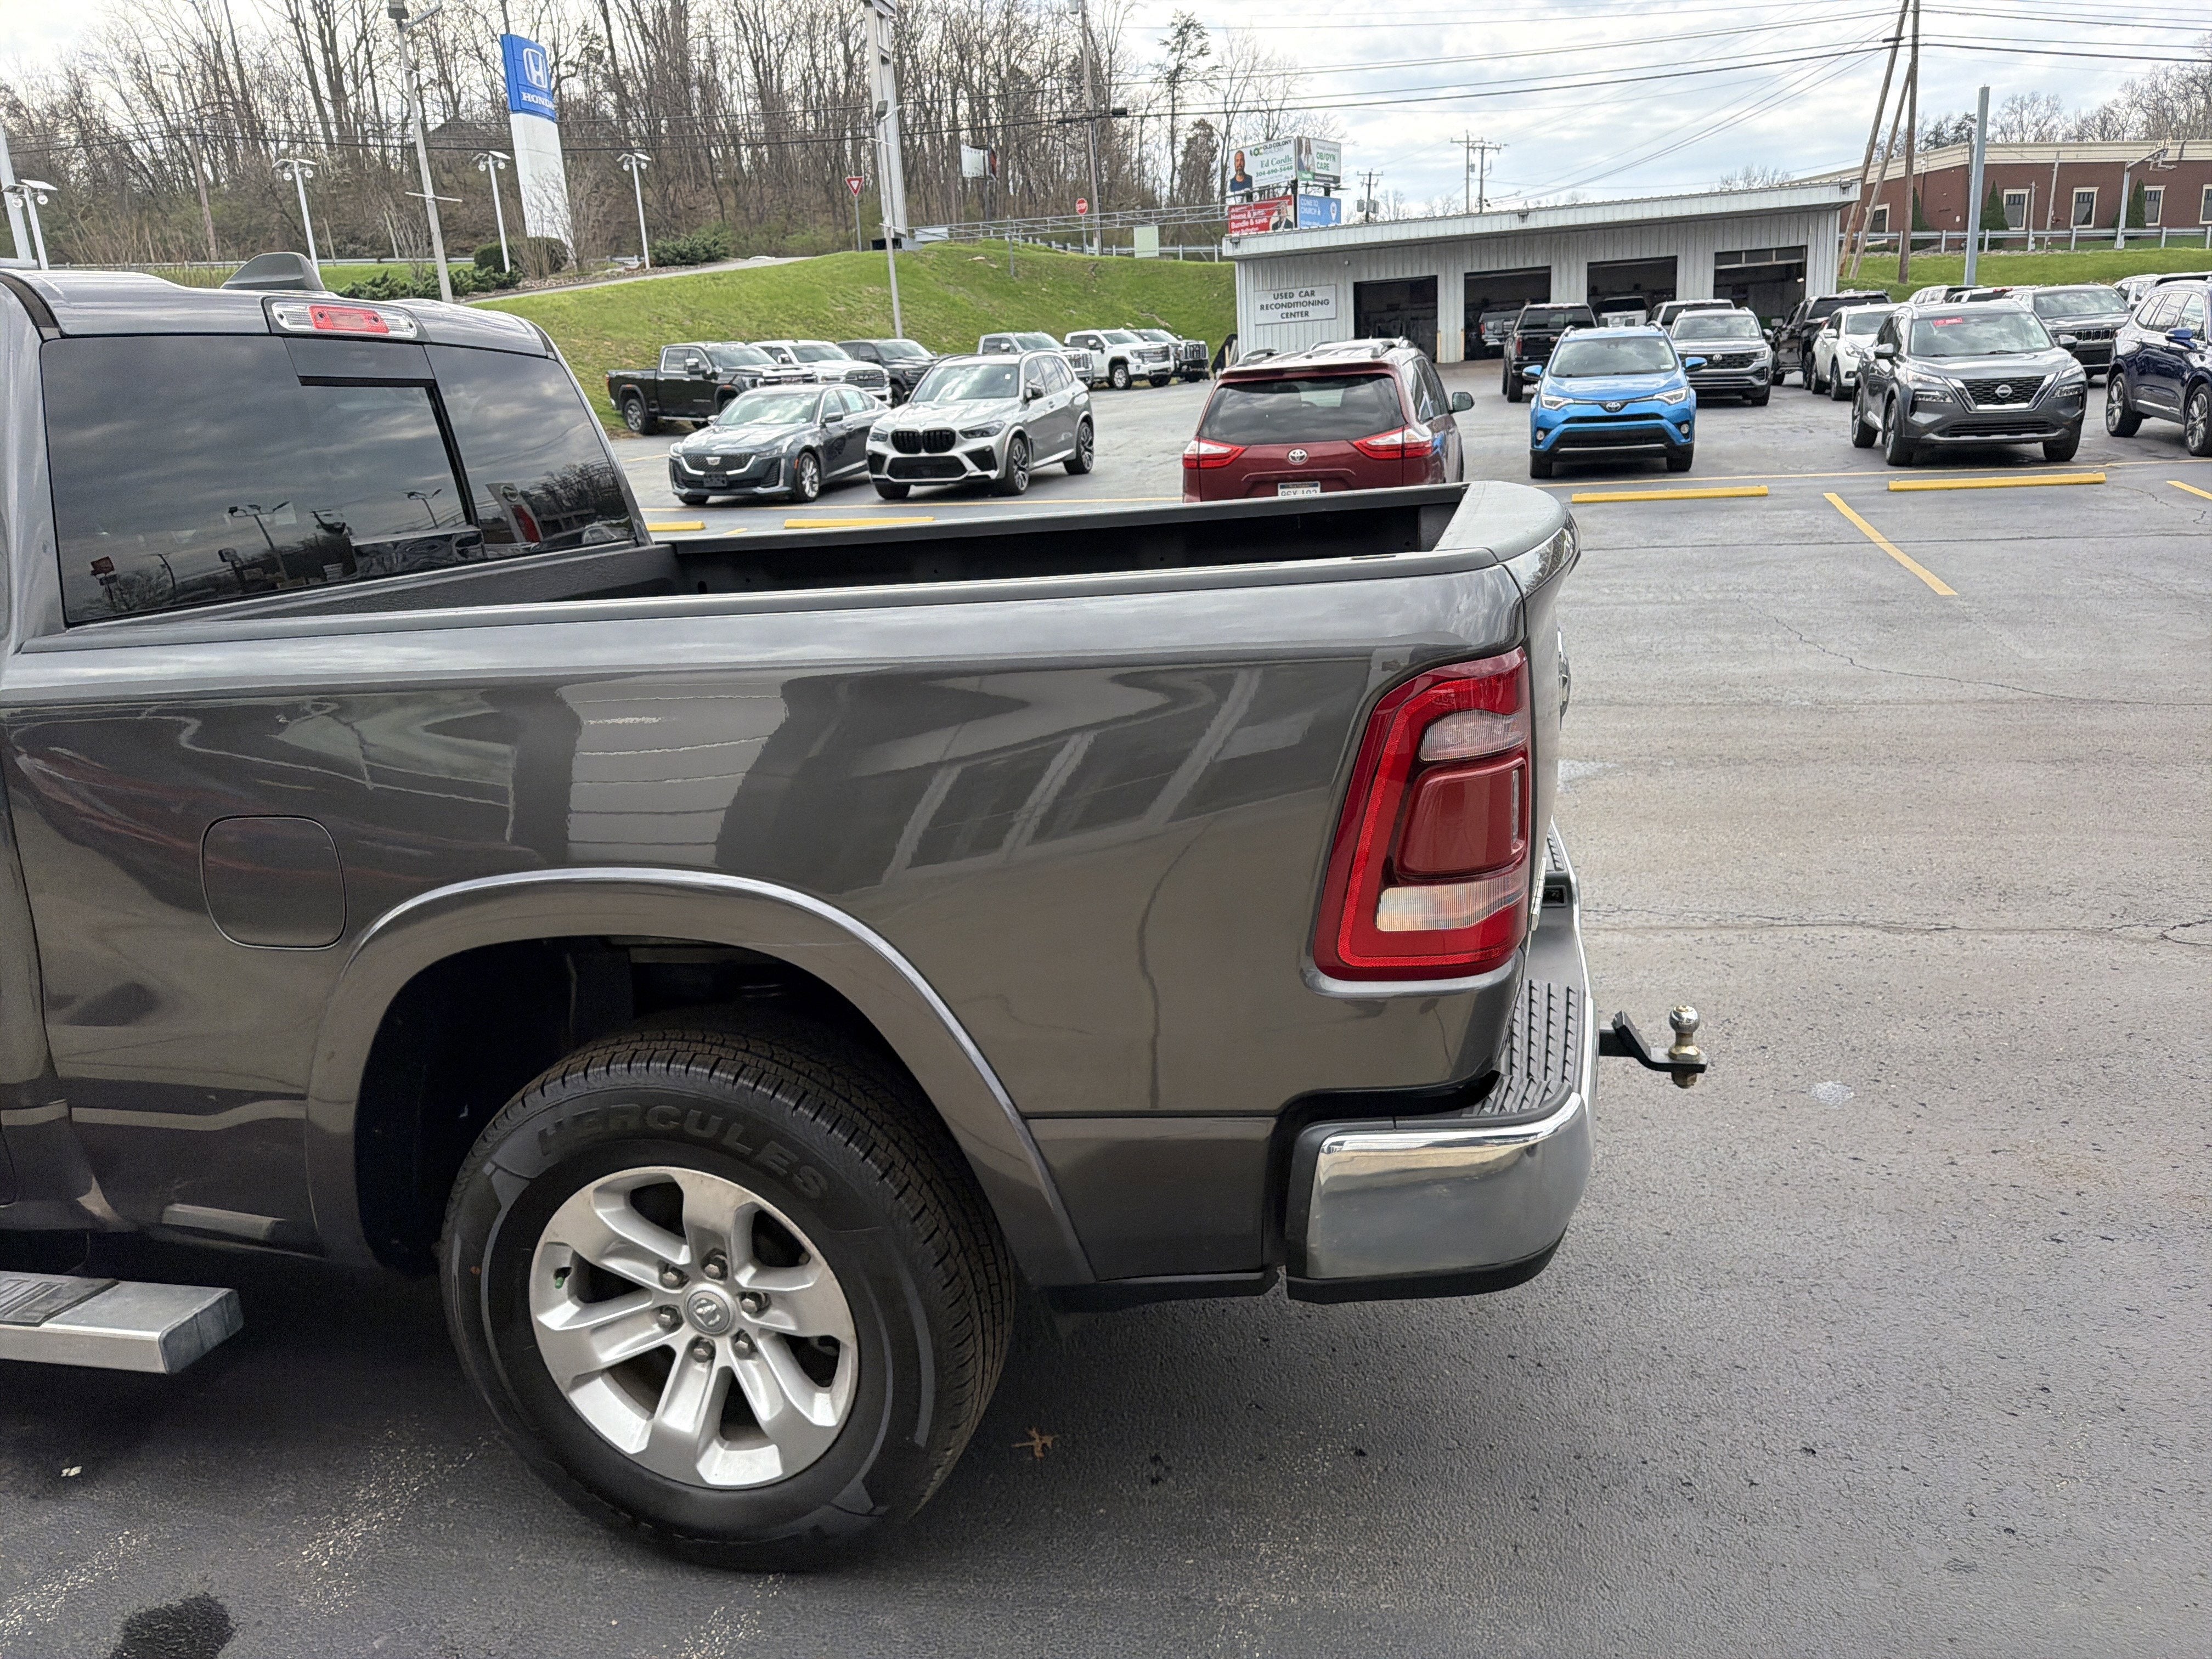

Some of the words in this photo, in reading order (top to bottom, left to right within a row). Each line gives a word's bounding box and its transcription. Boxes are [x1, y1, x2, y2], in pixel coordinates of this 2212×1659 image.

[521, 92, 555, 110] HONDA
[1273, 139, 1292, 148] COLONY
[1261, 159, 1269, 168] Ed
[1316, 161, 1330, 171] CARE
[1273, 291, 1295, 300] USED
[1260, 298, 1330, 311] RECONDITIONING
[1280, 311, 1310, 319] CENTER
[537, 1104, 827, 1199] HERCULES
